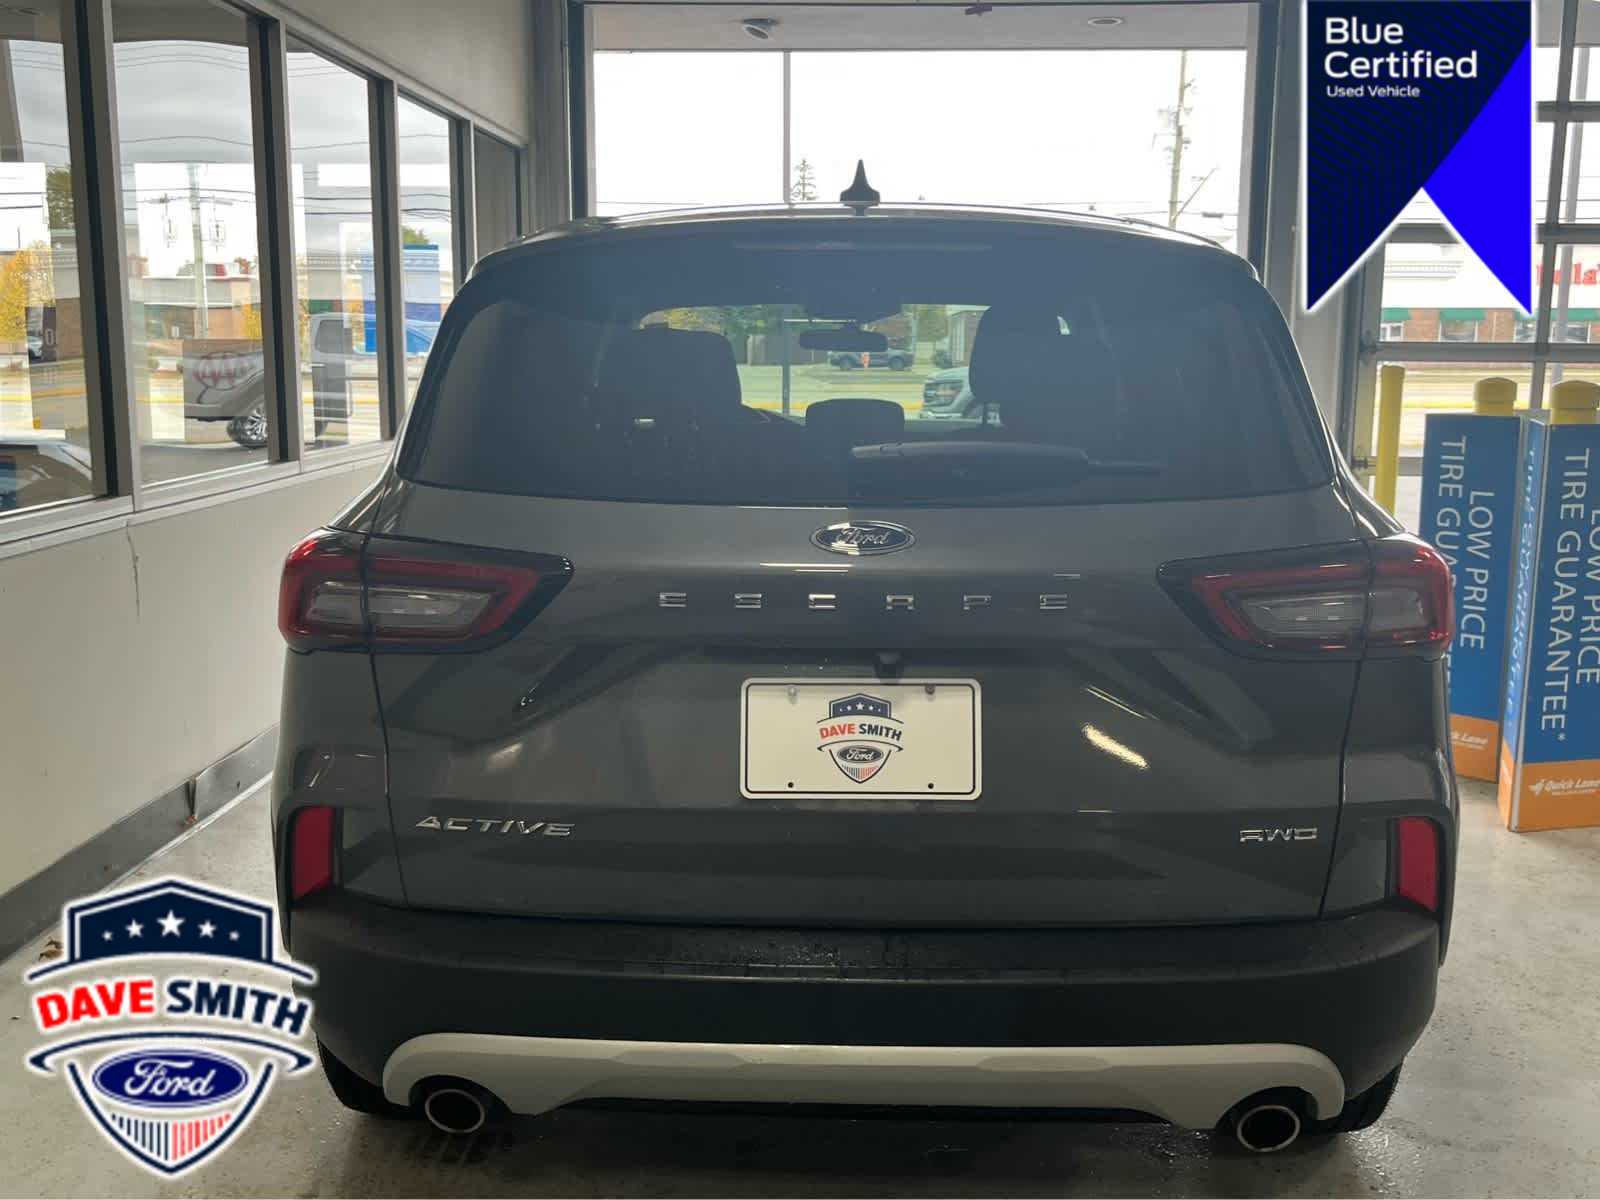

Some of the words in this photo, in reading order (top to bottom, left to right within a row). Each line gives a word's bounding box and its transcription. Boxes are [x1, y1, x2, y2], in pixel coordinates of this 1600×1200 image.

[1438, 435, 1467, 499] TIRE
[1560, 447, 1590, 520] TIRE
[1466, 490, 1495, 560] LOW
[658, 592, 1069, 610] ESCAPE
[1459, 567, 1489, 649] PRICE
[819, 722, 857, 740] DAVE
[858, 722, 903, 742] SMITH
[845, 747, 875, 762] Ford
[415, 815, 576, 837] ACTIVE
[1239, 827, 1318, 842] AWD
